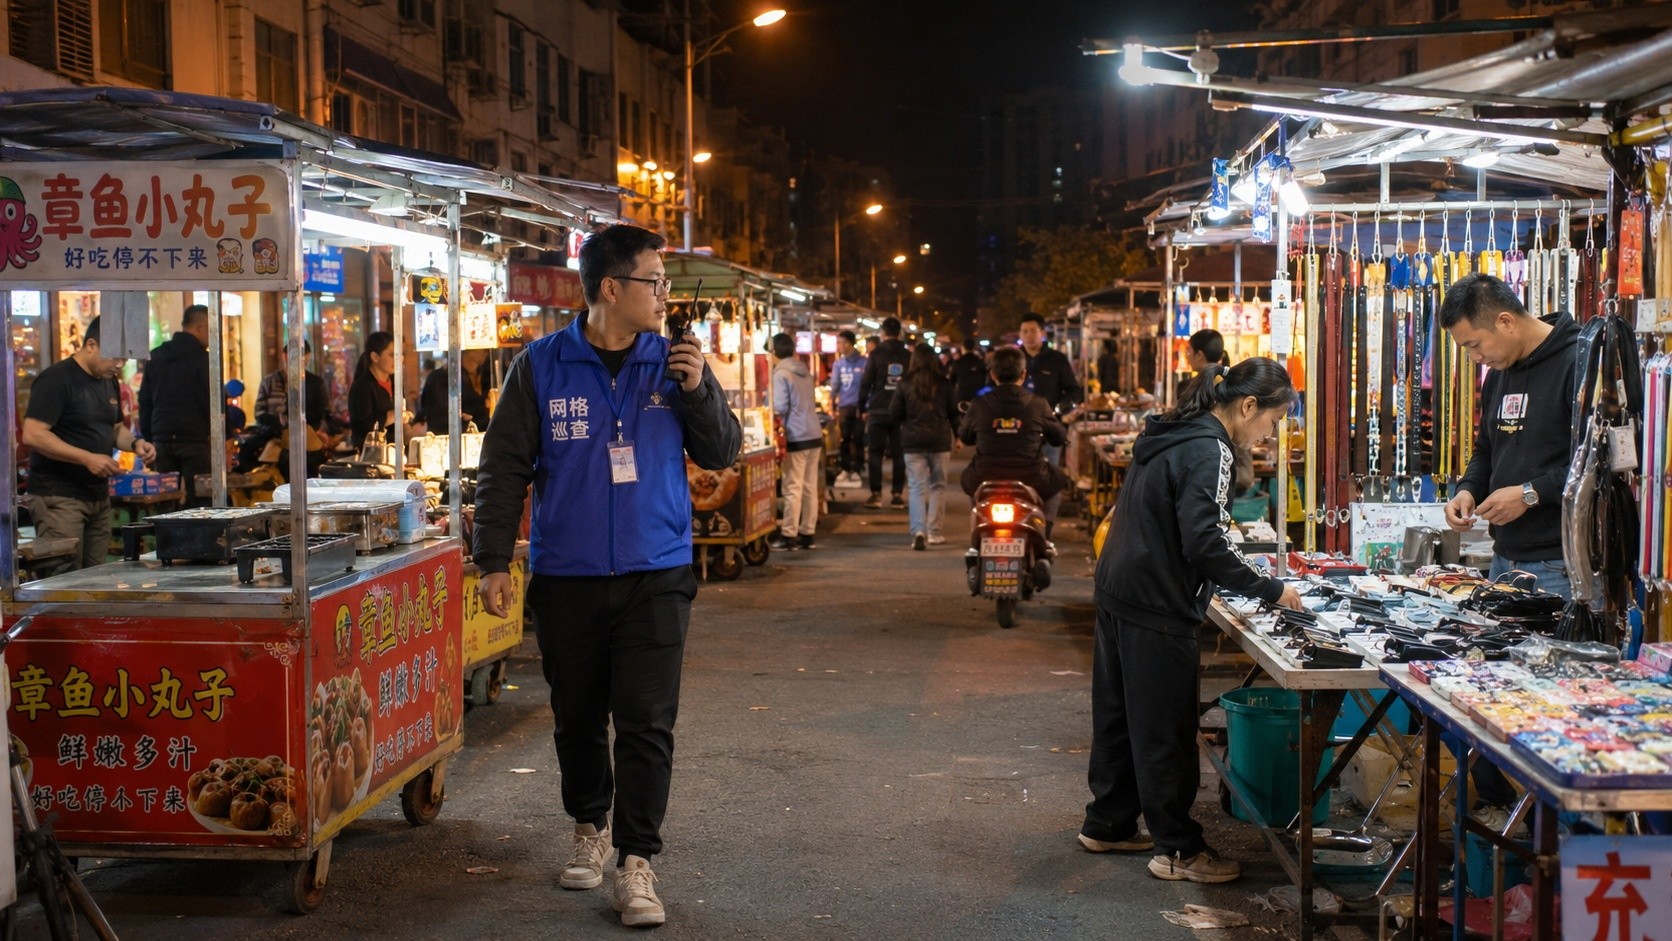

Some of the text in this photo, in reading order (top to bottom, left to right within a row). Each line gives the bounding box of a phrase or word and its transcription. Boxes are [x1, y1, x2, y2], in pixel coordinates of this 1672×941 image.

[41, 173, 272, 240] 章鱼小丸子
[64, 246, 208, 269] 好吃停不下来
[549, 396, 589, 419] 网格
[551, 420, 590, 442] 巡查
[11, 664, 236, 722] 章鱼小丸子
[58, 734, 198, 771] 鲜嫩多汁
[1577, 851, 1655, 941] 充
